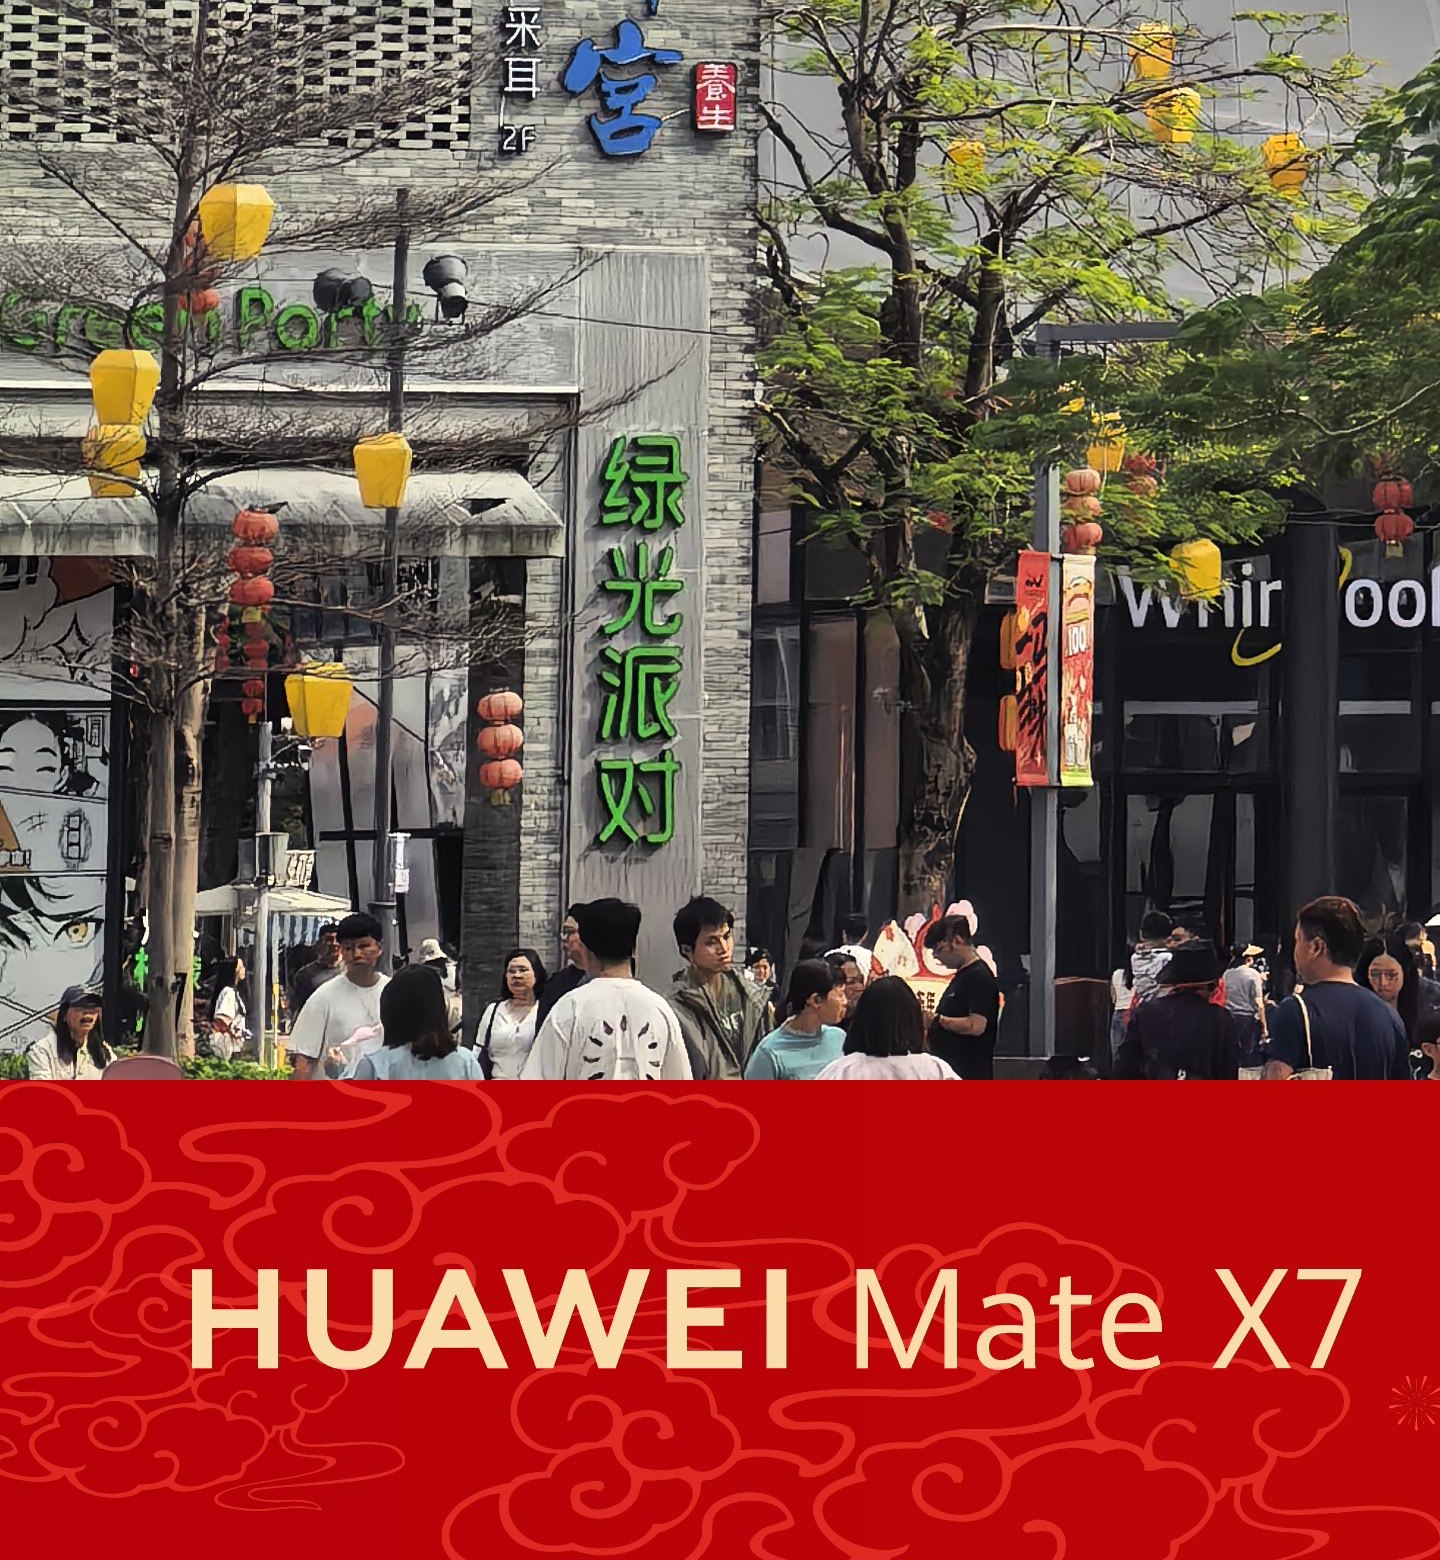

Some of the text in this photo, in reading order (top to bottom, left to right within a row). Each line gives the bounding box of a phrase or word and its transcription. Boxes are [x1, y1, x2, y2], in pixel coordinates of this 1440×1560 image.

[503, 124, 536, 154] 2F
[600, 435, 689, 842] 绿光派对
